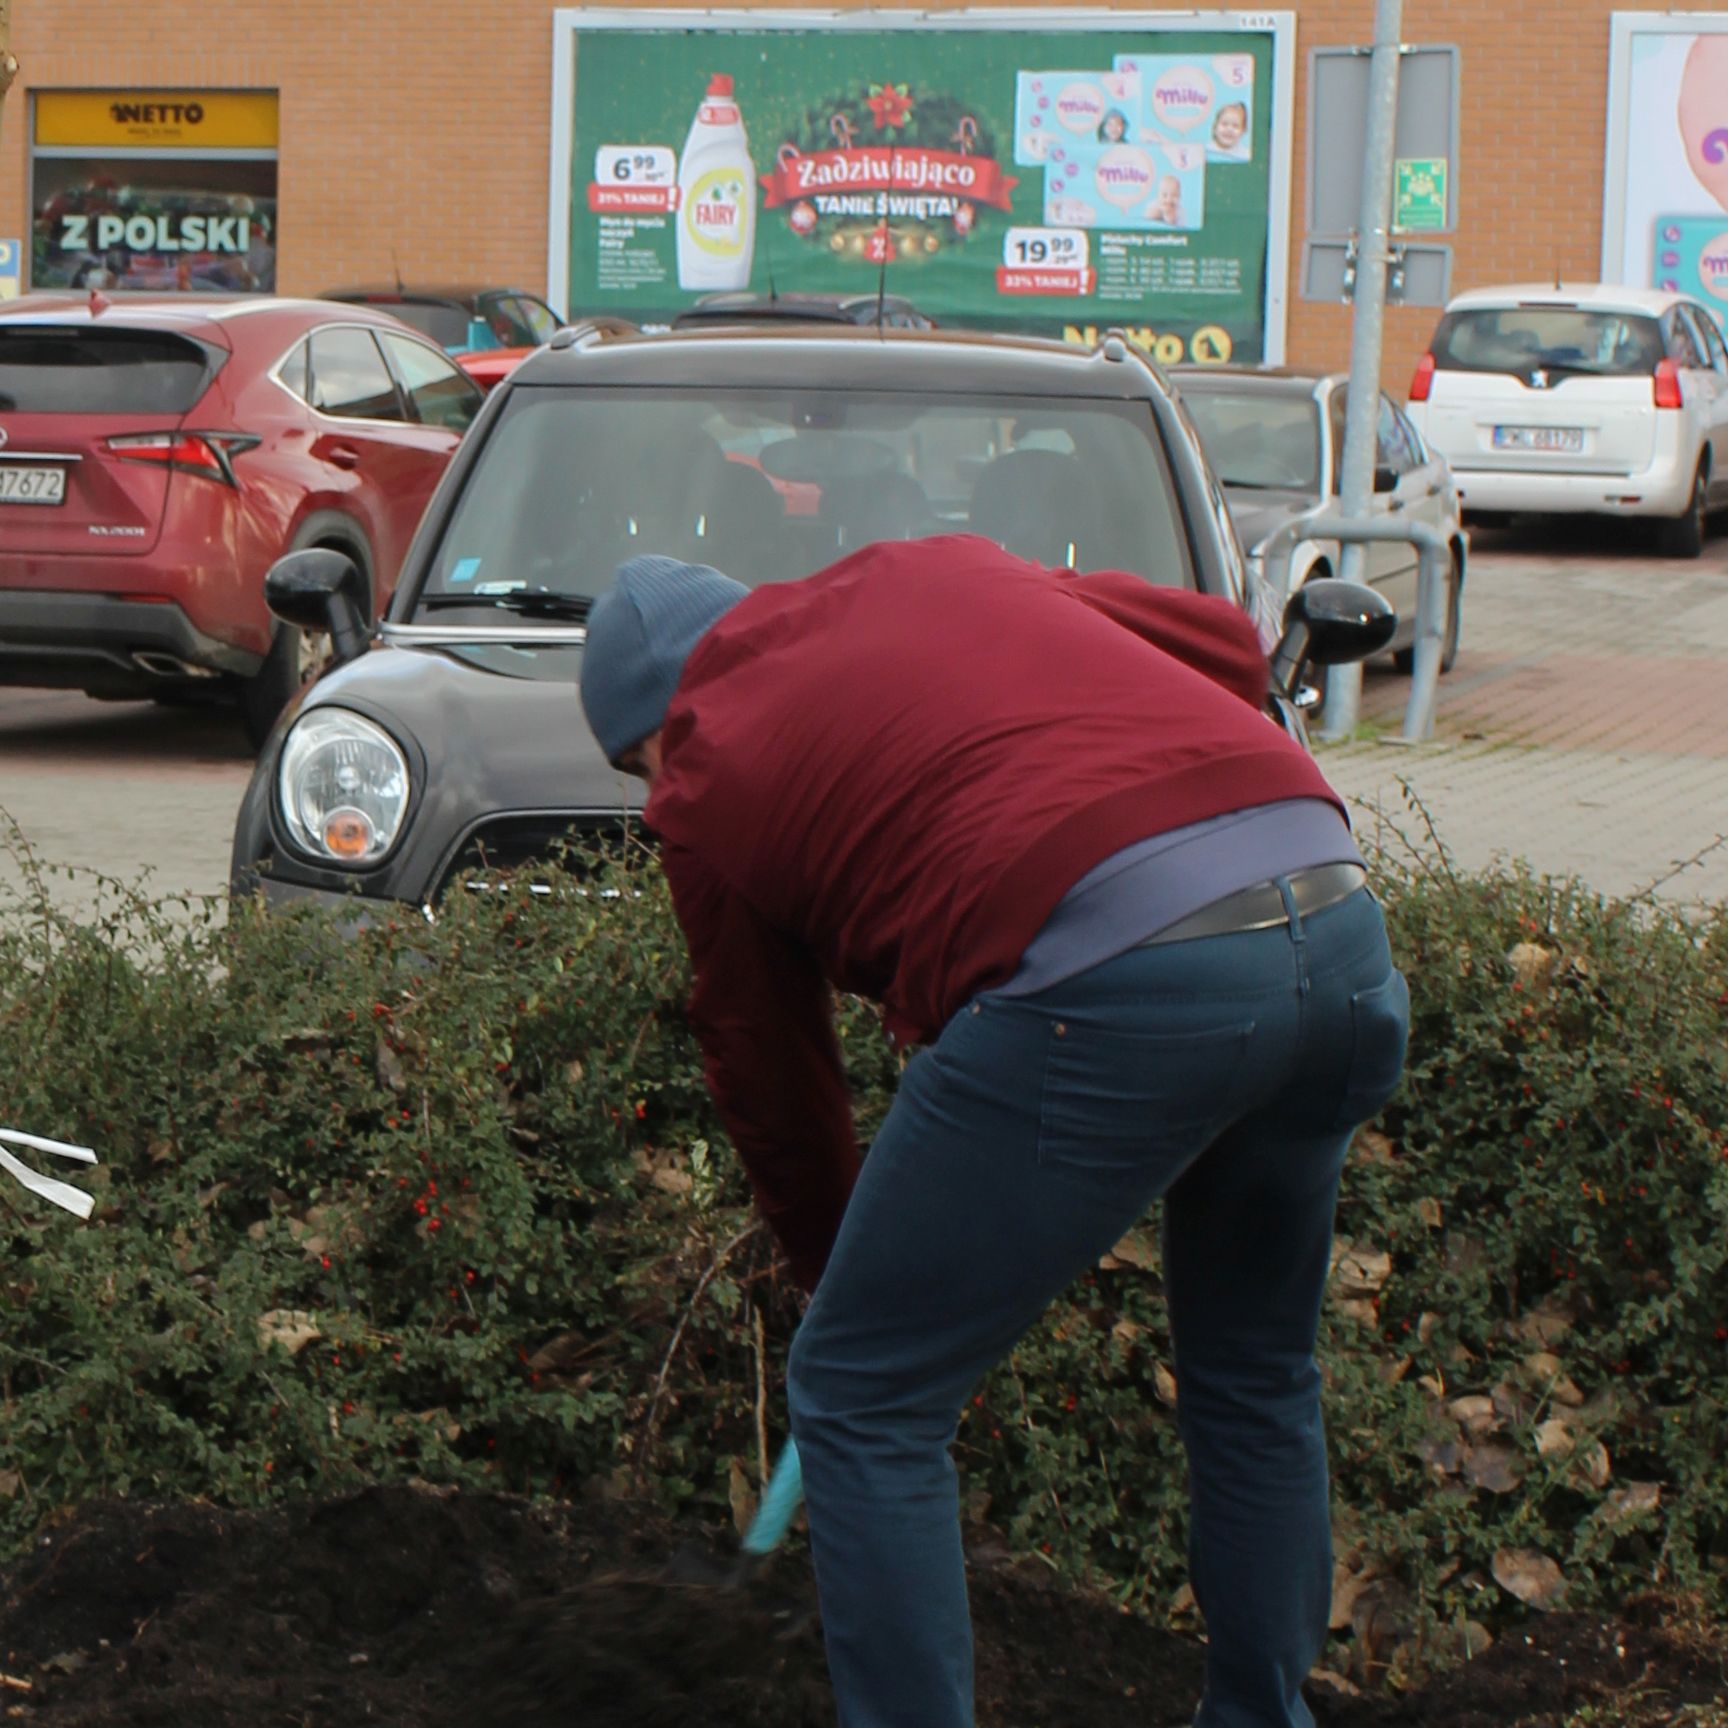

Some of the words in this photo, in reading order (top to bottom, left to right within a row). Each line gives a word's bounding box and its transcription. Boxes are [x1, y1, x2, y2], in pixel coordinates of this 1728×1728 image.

[110, 102, 205, 124] NETTO
[696, 204, 736, 226] FAIRY
[60, 214, 90, 250] Z
[97, 215, 251, 253] POLSKI
